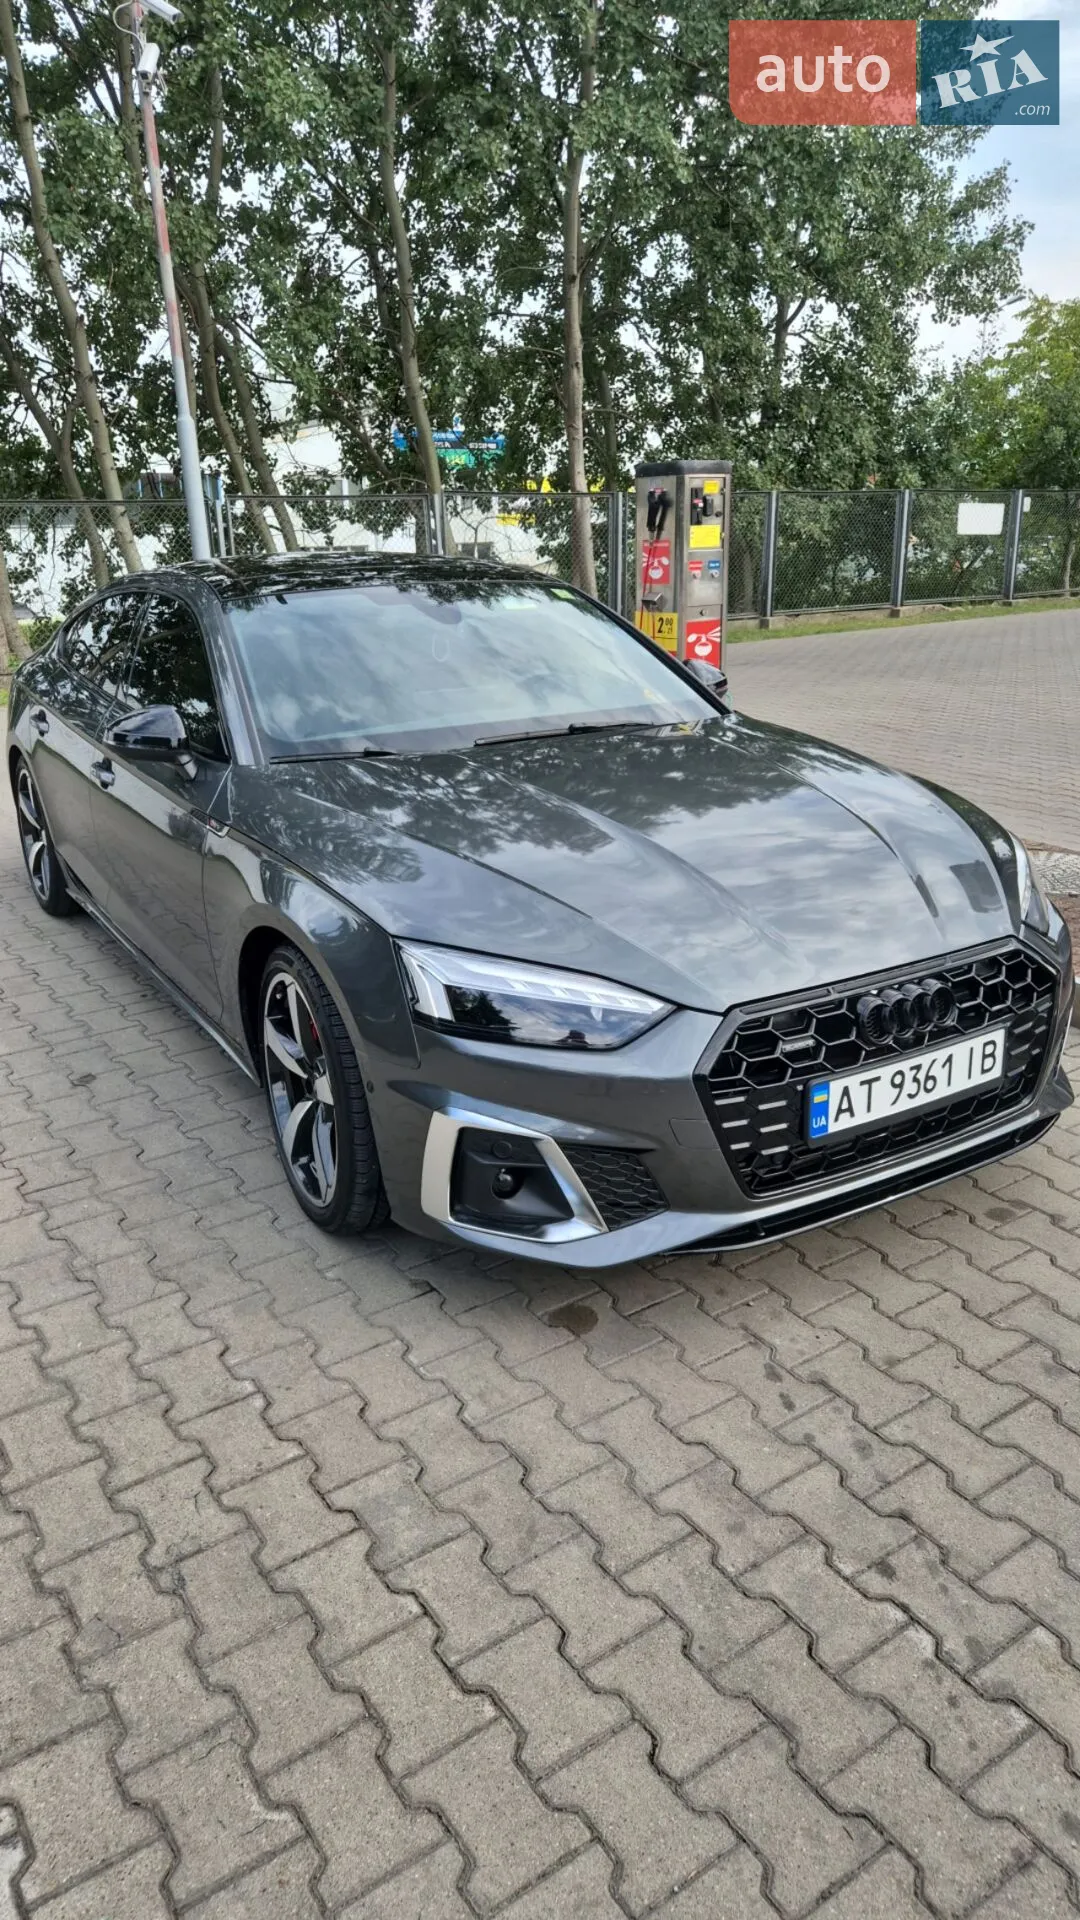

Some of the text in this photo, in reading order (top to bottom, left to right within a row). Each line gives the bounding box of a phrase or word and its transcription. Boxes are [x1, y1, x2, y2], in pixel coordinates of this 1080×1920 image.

[834, 1039, 997, 1123] AT 9361 IB
[812, 1115, 827, 1129] UA
